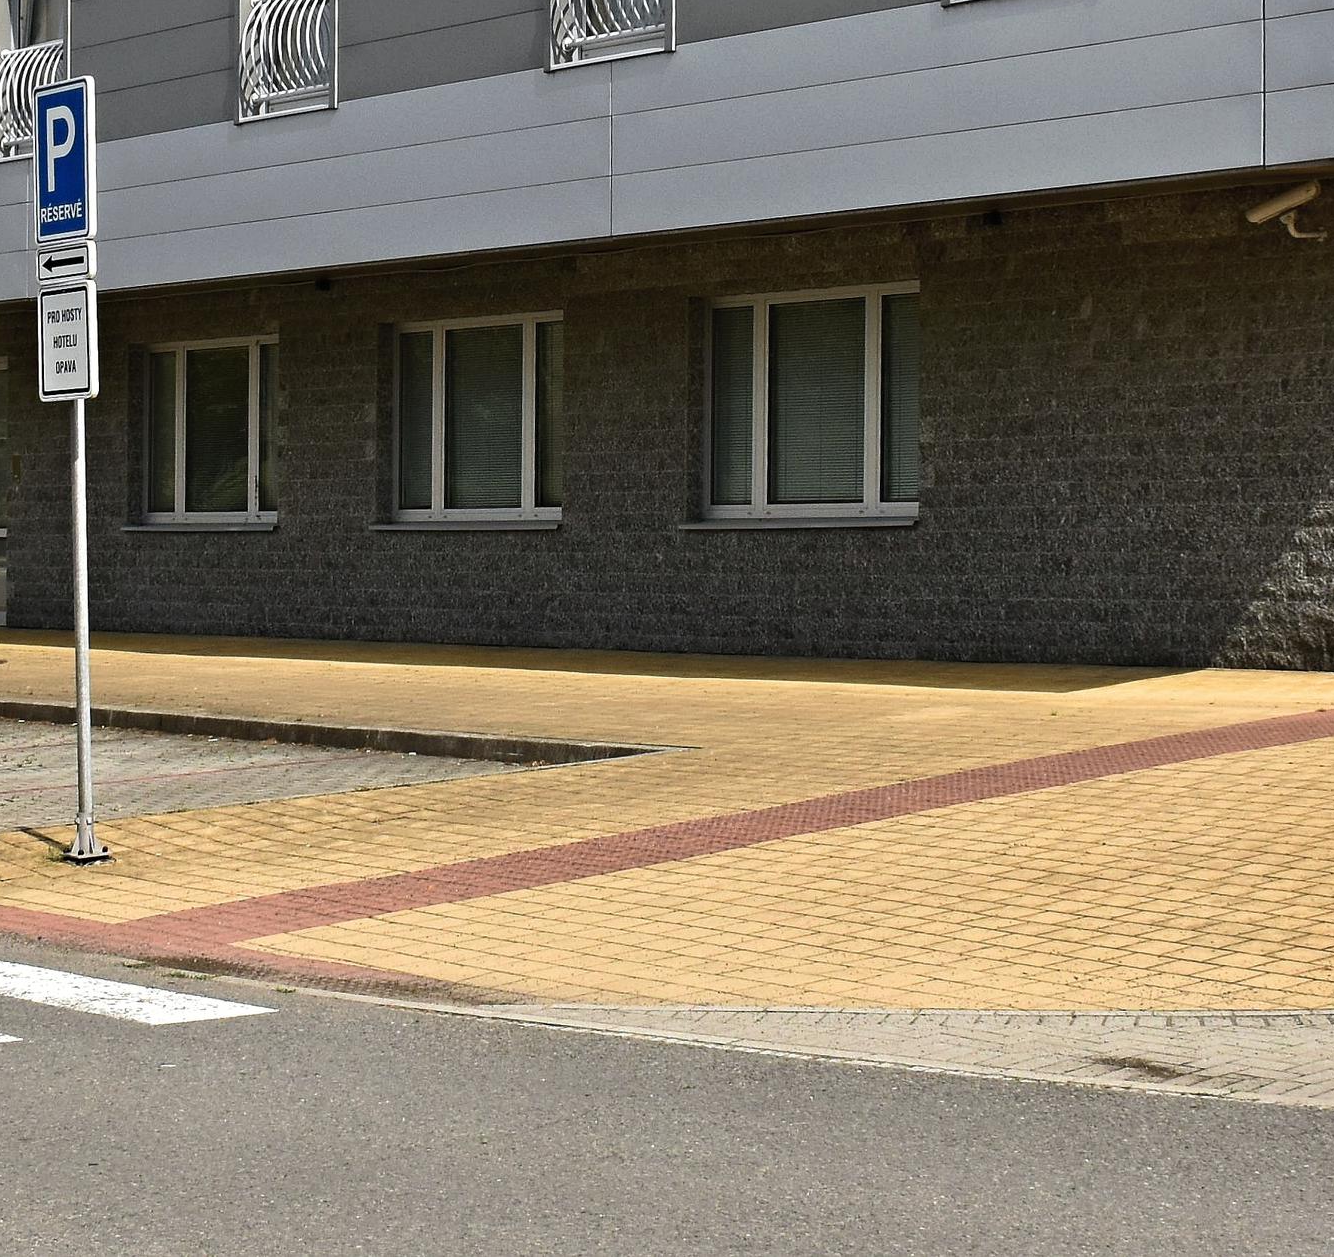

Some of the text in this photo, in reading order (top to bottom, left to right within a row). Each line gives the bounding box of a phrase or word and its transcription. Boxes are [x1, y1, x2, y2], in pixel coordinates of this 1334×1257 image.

[46, 105, 76, 192] P
[40, 198, 83, 223] RÉSERVÉ
[47, 307, 82, 324] PRO HOSTY
[53, 334, 78, 349] HOTELU
[55, 359, 77, 374] OPAVA
